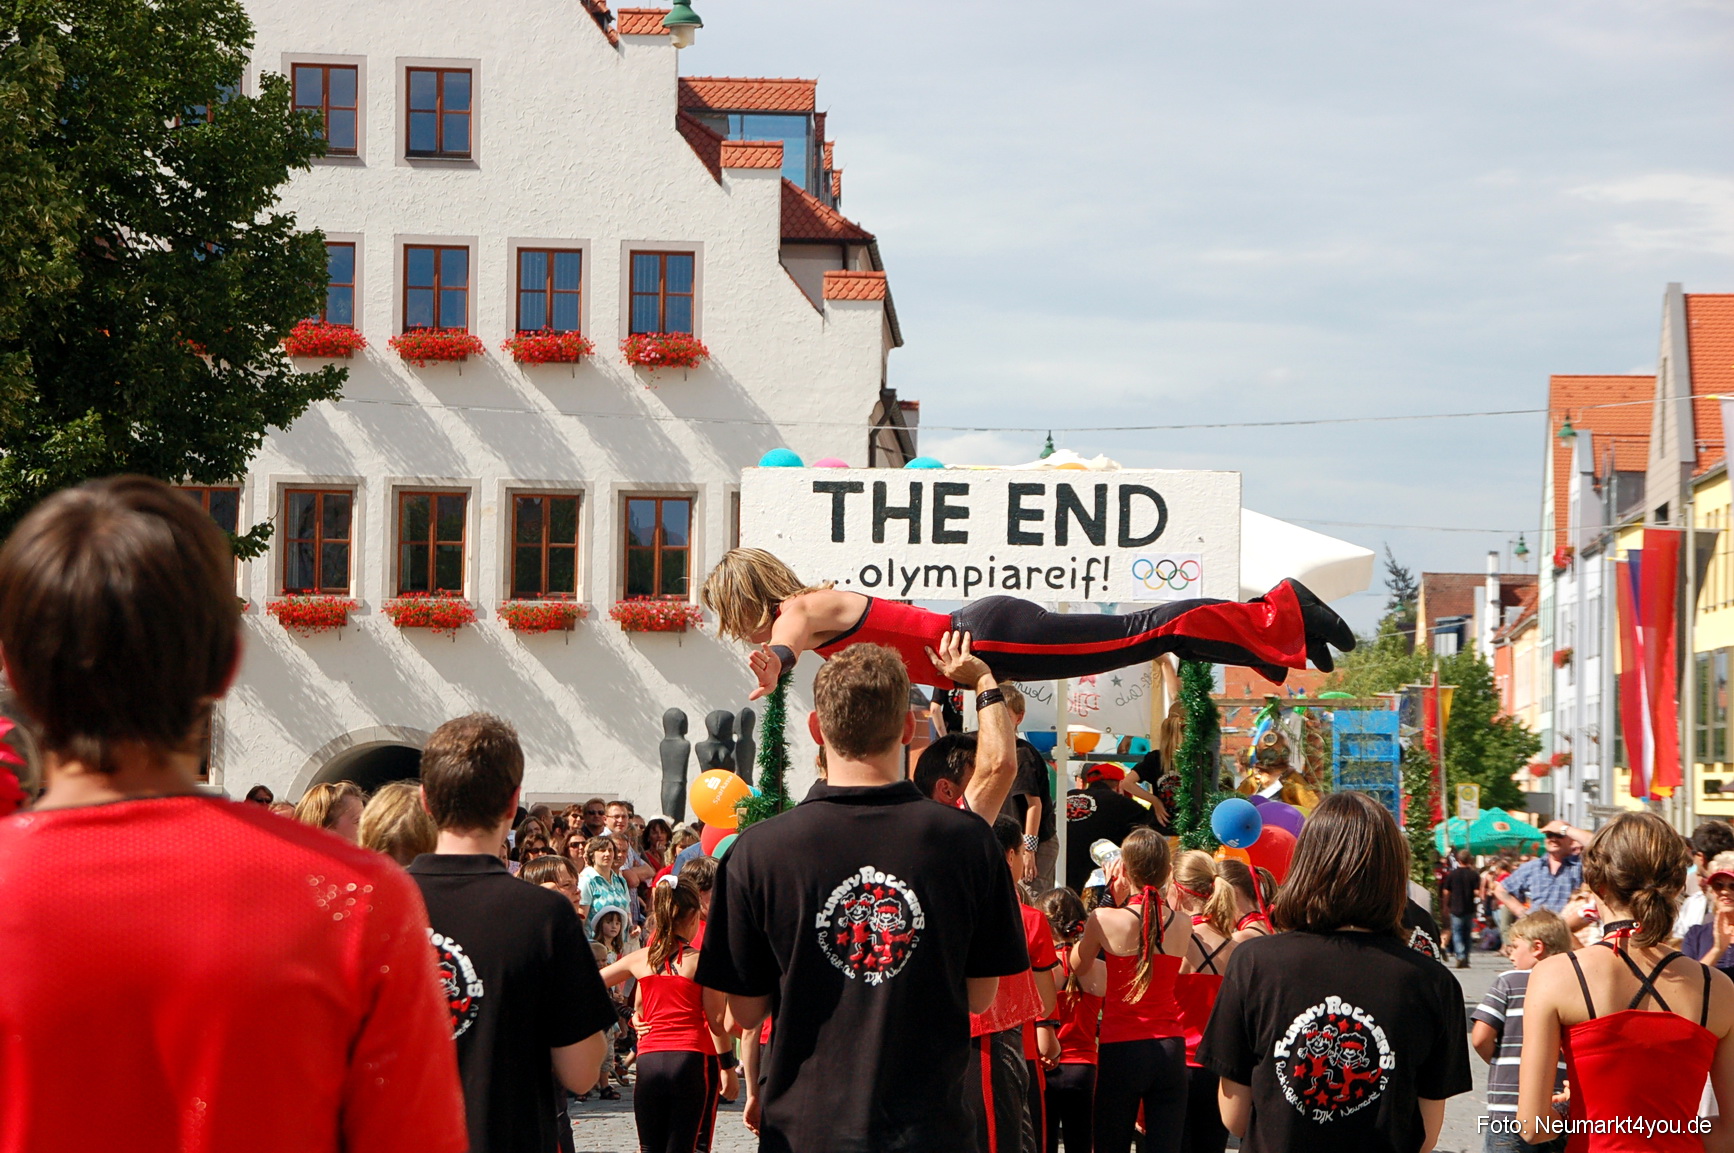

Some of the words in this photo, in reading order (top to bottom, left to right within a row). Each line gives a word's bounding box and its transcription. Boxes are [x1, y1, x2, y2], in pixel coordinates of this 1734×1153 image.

[812, 481, 970, 545] THE
[1007, 483, 1168, 548] END
[1312, 1109, 1333, 1125] DJK
